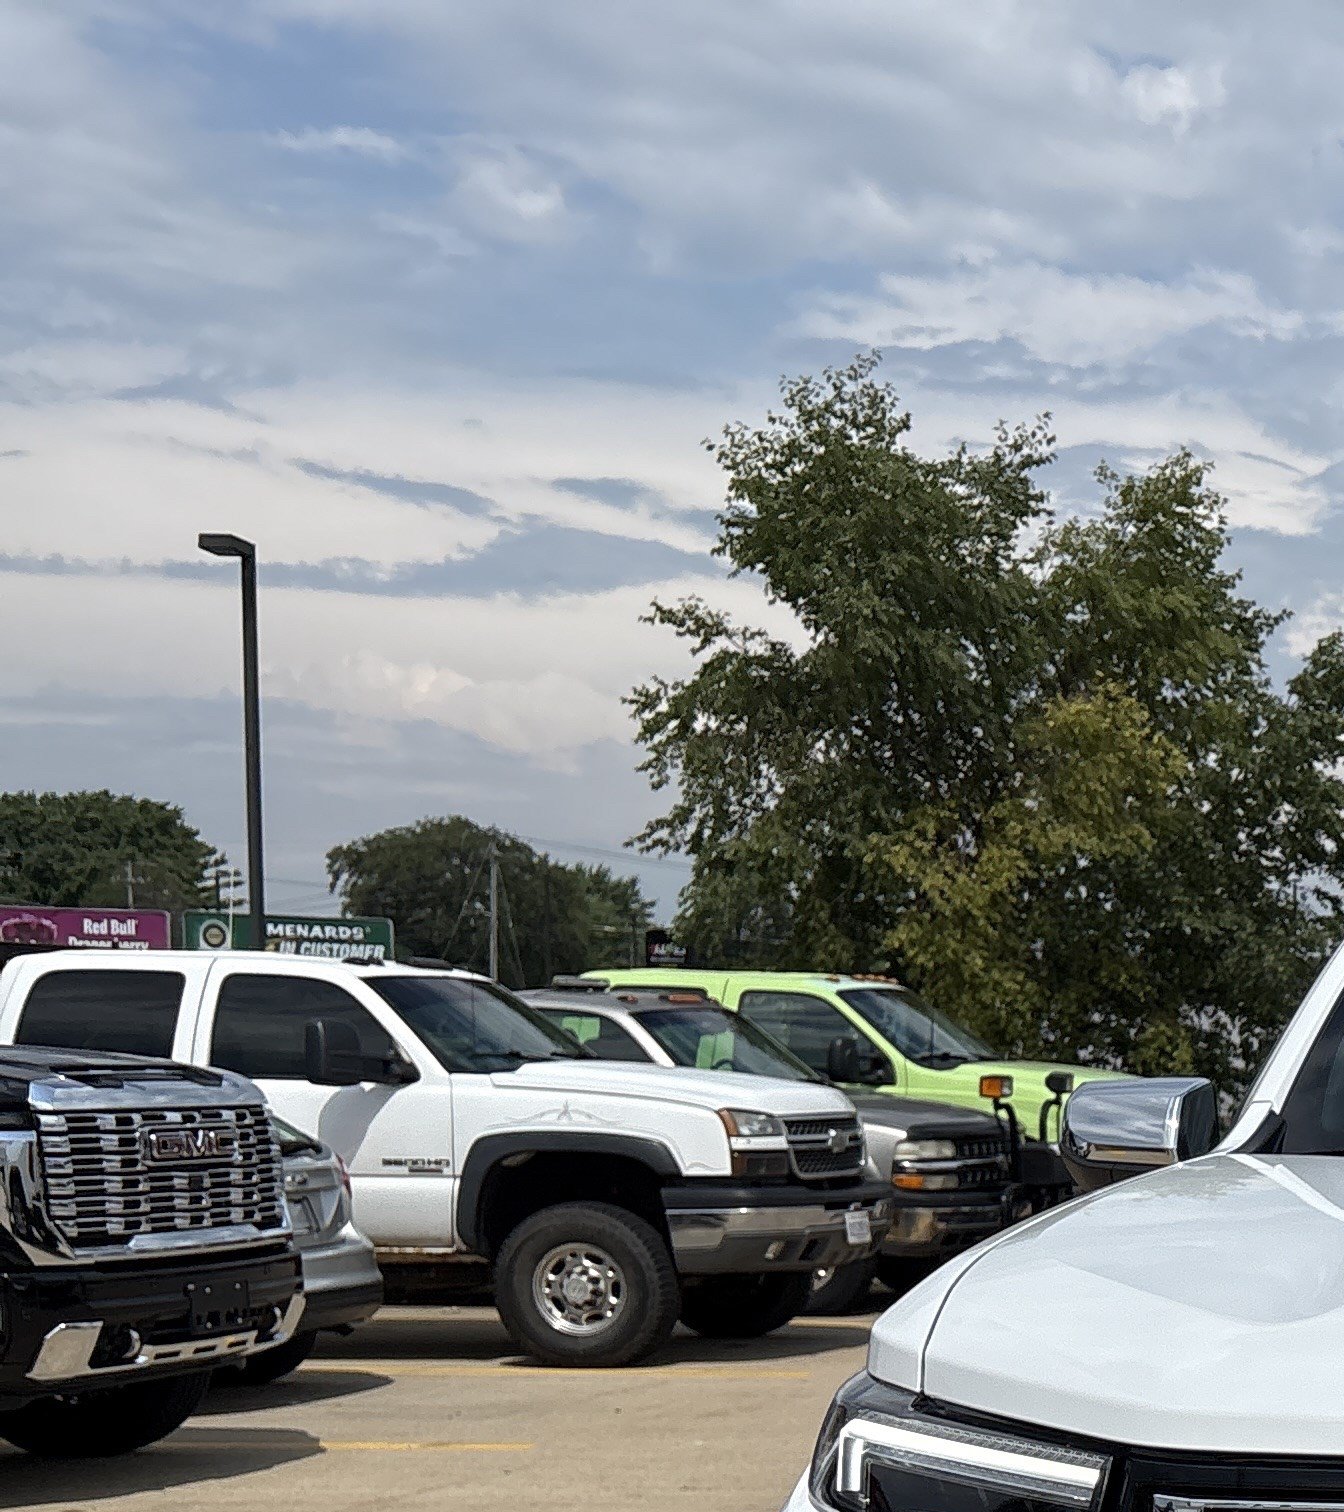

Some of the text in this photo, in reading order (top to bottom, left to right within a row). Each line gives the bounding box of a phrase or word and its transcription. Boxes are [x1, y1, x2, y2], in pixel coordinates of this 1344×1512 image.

[82, 917, 137, 936] Red Bull
[265, 922, 366, 940] MENARDS
[299, 942, 386, 961] CUSTOMER
